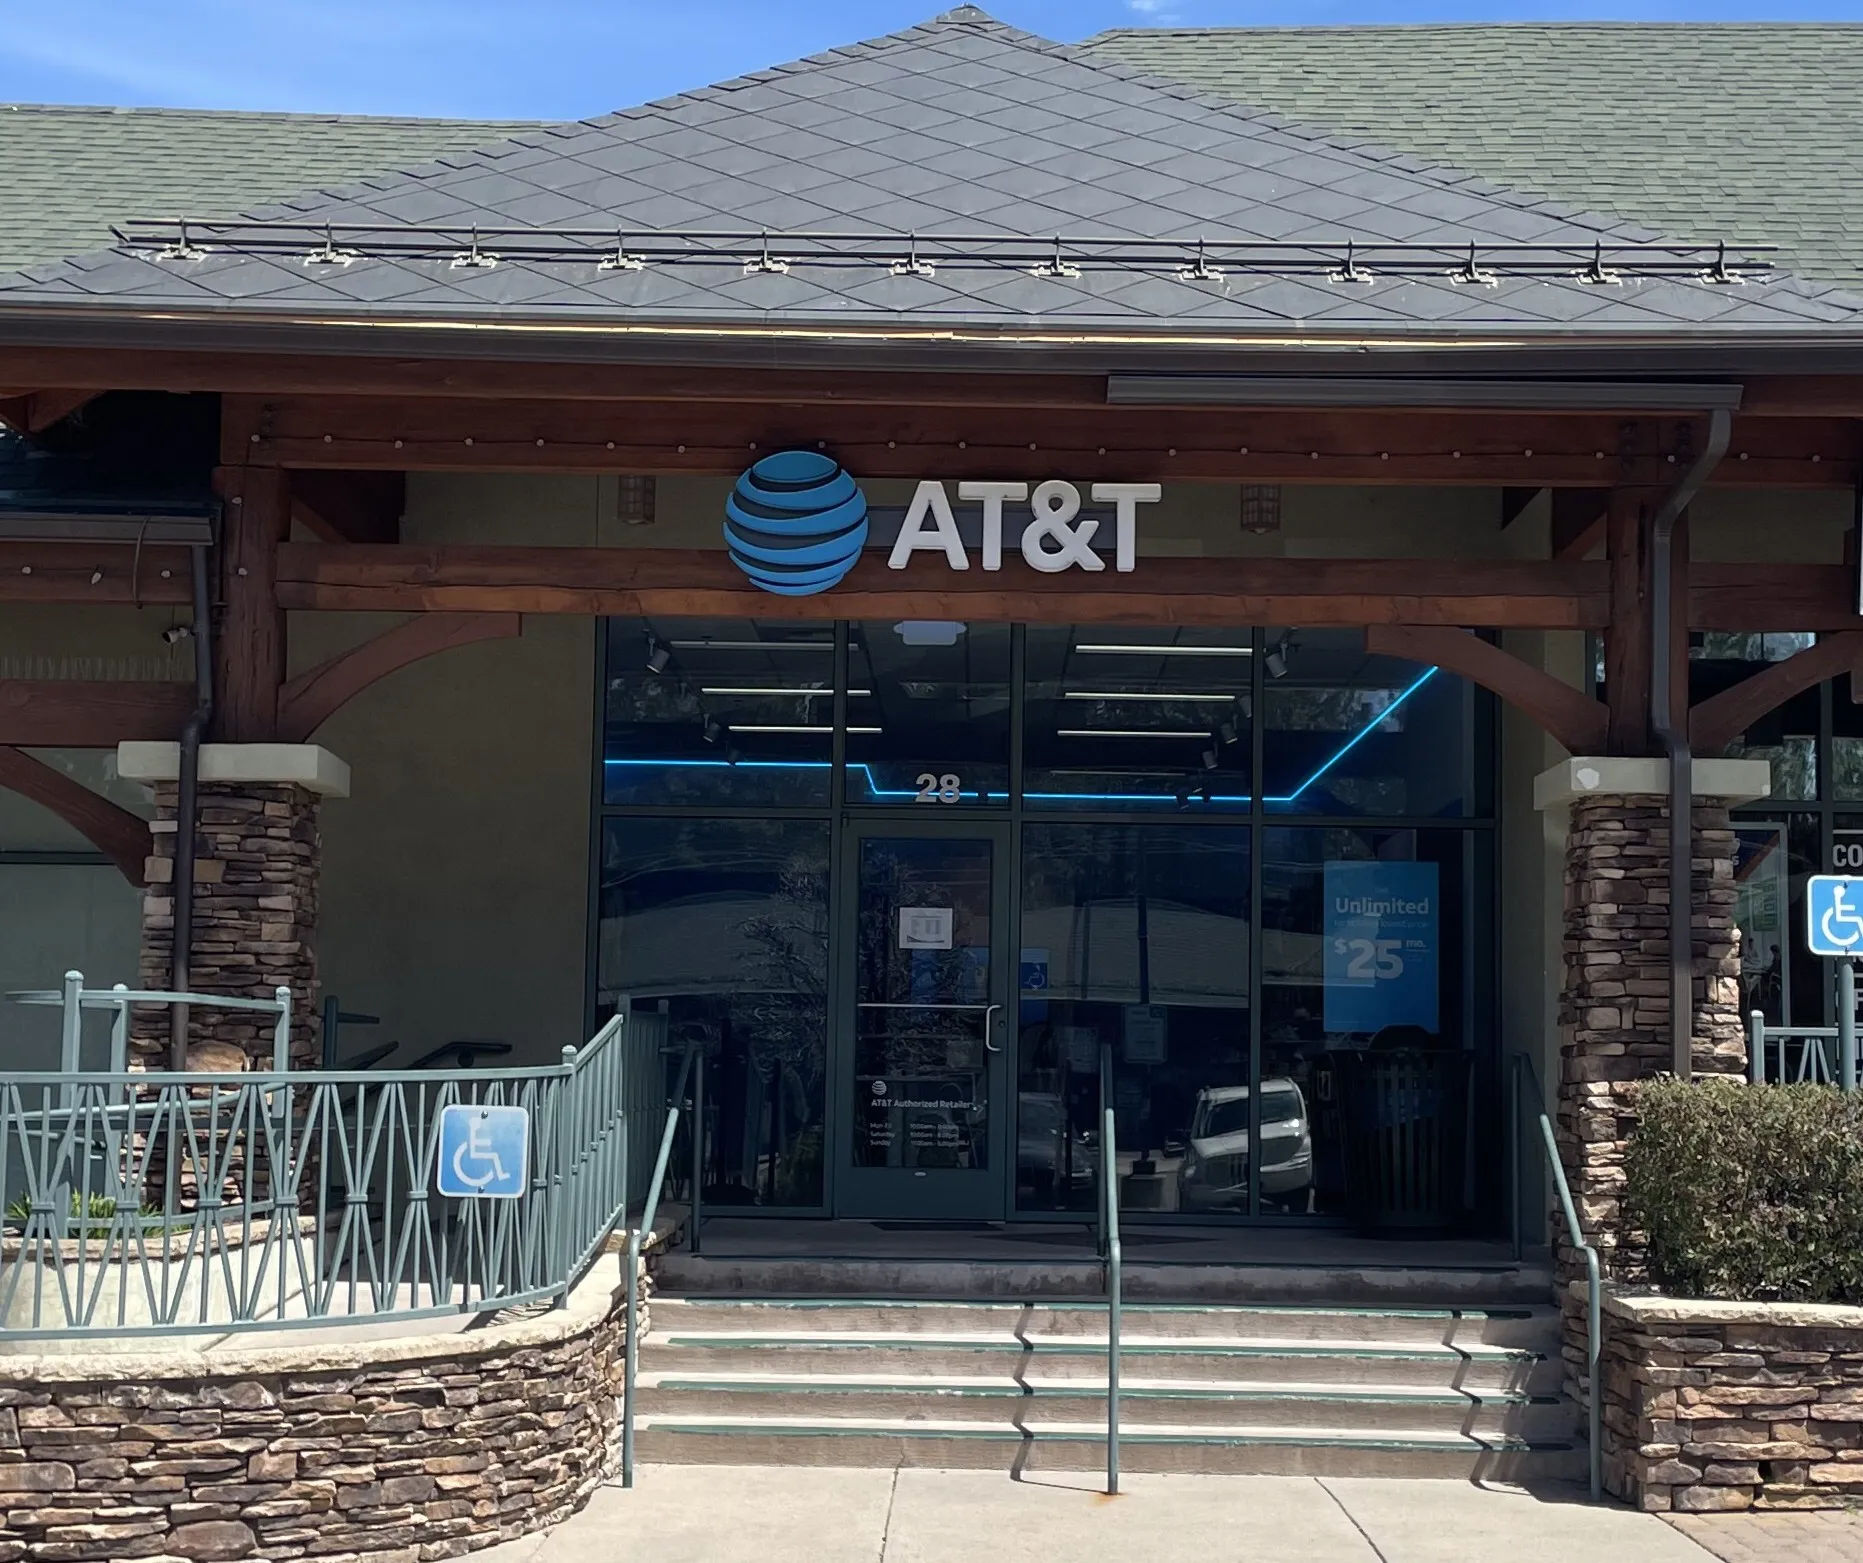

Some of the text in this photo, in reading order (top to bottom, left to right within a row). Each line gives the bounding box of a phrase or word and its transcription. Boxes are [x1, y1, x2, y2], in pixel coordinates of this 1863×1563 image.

[887, 479, 1162, 572] AT&T
[915, 773, 960, 804] 28
[1335, 896, 1429, 914] Unlimited
[1334, 937, 1404, 979] $25
[871, 1099, 971, 1108] AT&T Authorized Retailer
